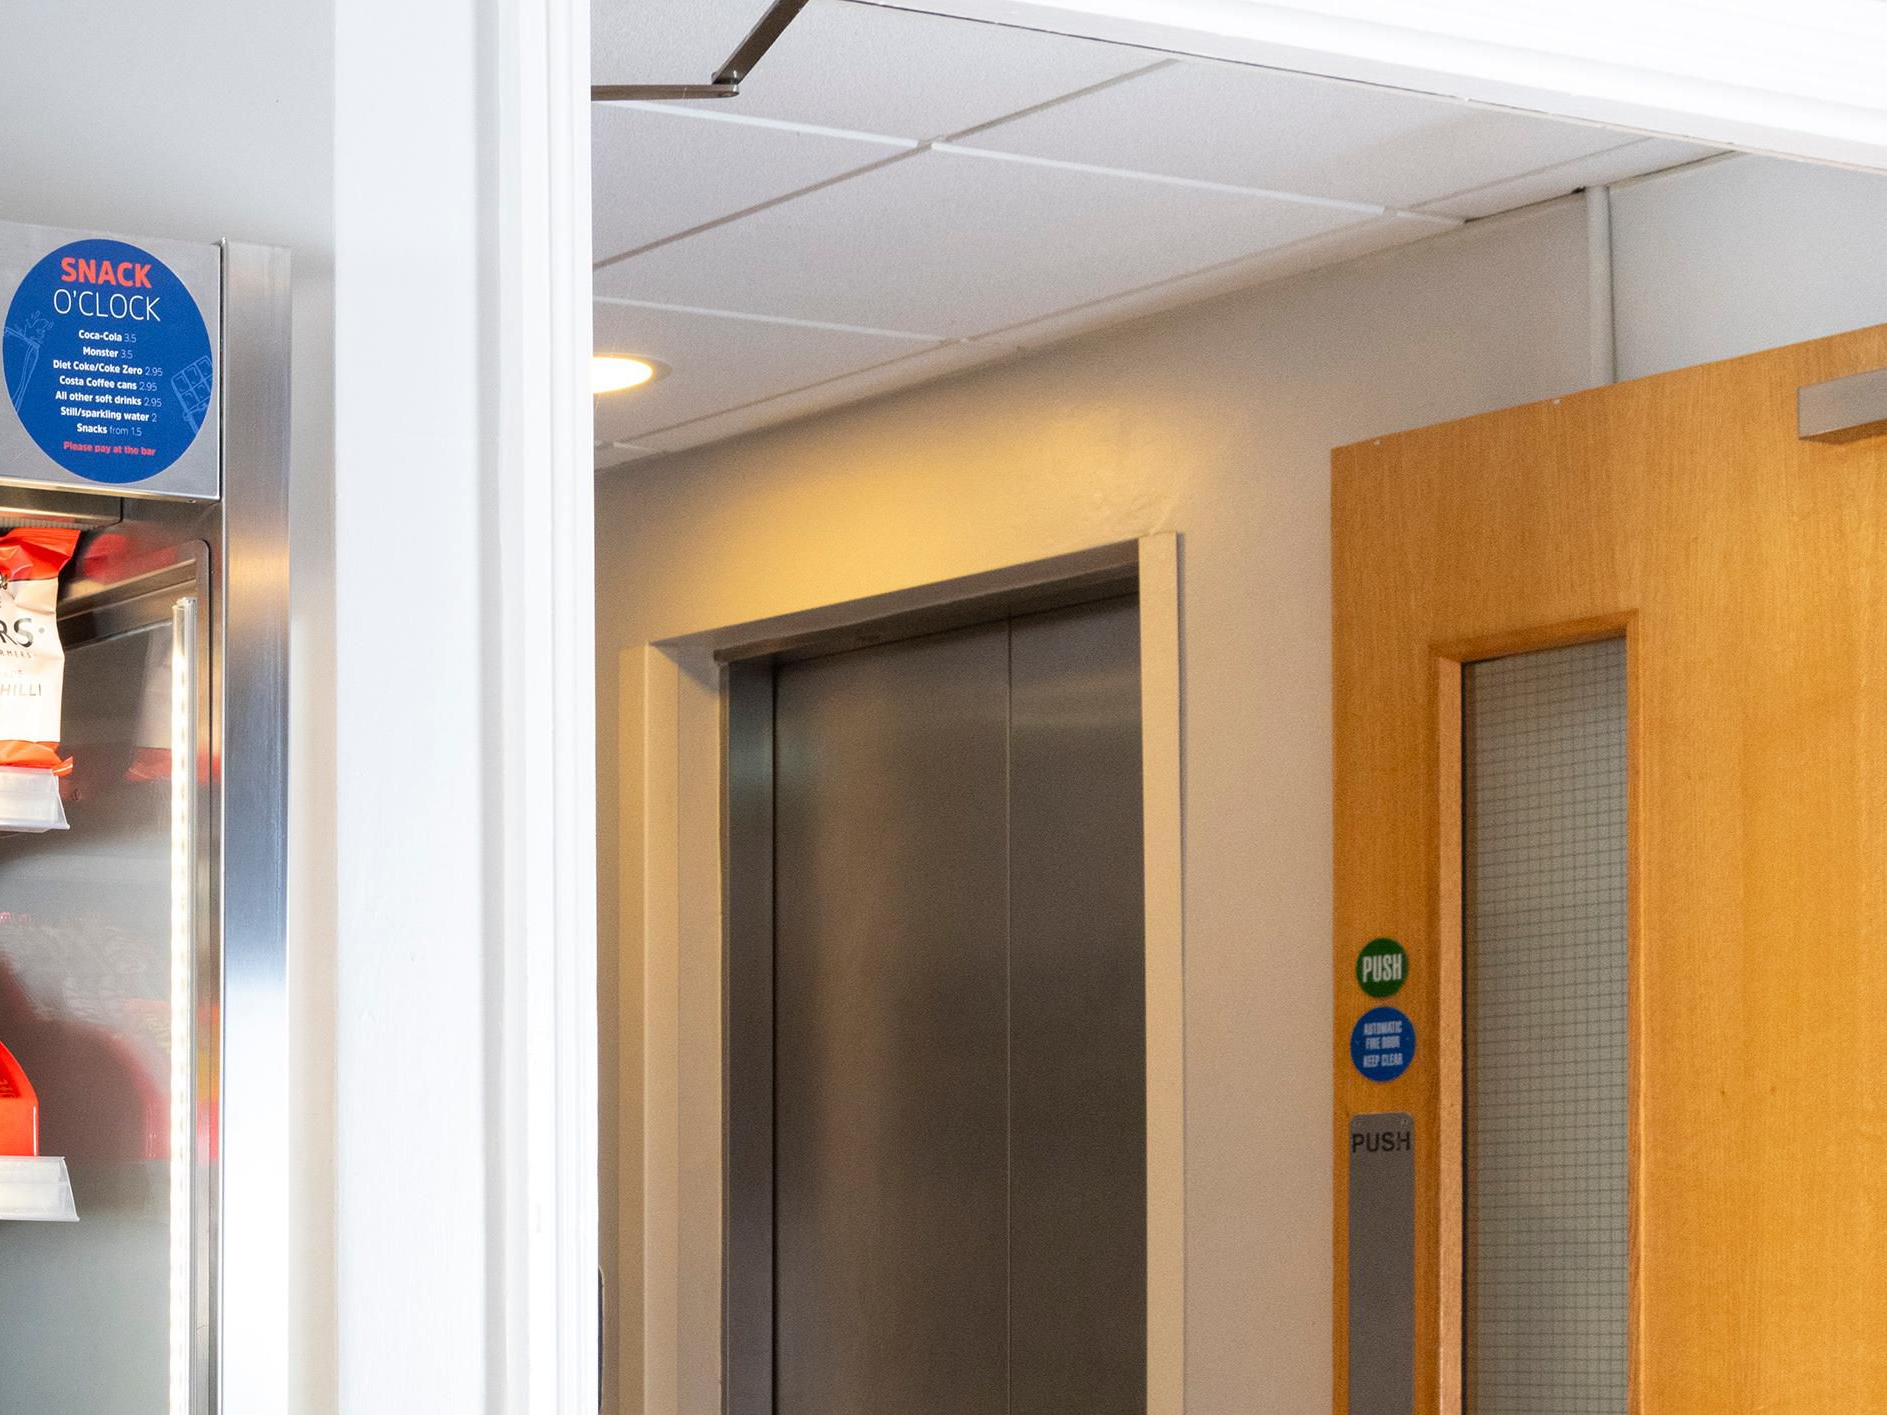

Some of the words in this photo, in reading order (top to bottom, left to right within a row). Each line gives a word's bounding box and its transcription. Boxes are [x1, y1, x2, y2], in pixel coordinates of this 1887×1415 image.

[60, 256, 152, 288] SNACK
[54, 289, 160, 321] O'CLOCK
[78, 330, 122, 342] Coca-Cola
[124, 334, 136, 342] 3.5
[83, 346, 118, 358] Monster
[121, 350, 132, 358] 3.5
[53, 360, 71, 370] Diet
[73, 361, 120, 373] Coke/Coke
[122, 364, 142, 375] Zero
[146, 367, 162, 376] 2.95
[60, 376, 84, 386] Costa
[86, 378, 115, 388] Coffee
[117, 382, 137, 390] cans
[140, 382, 156, 391] 2.95
[1362, 954, 1402, 983] PUSH
[1363, 1054, 1380, 1068] KEEP
[1381, 1053, 1403, 1066] CLEAR
[1352, 1132, 1411, 1152] PUSH
